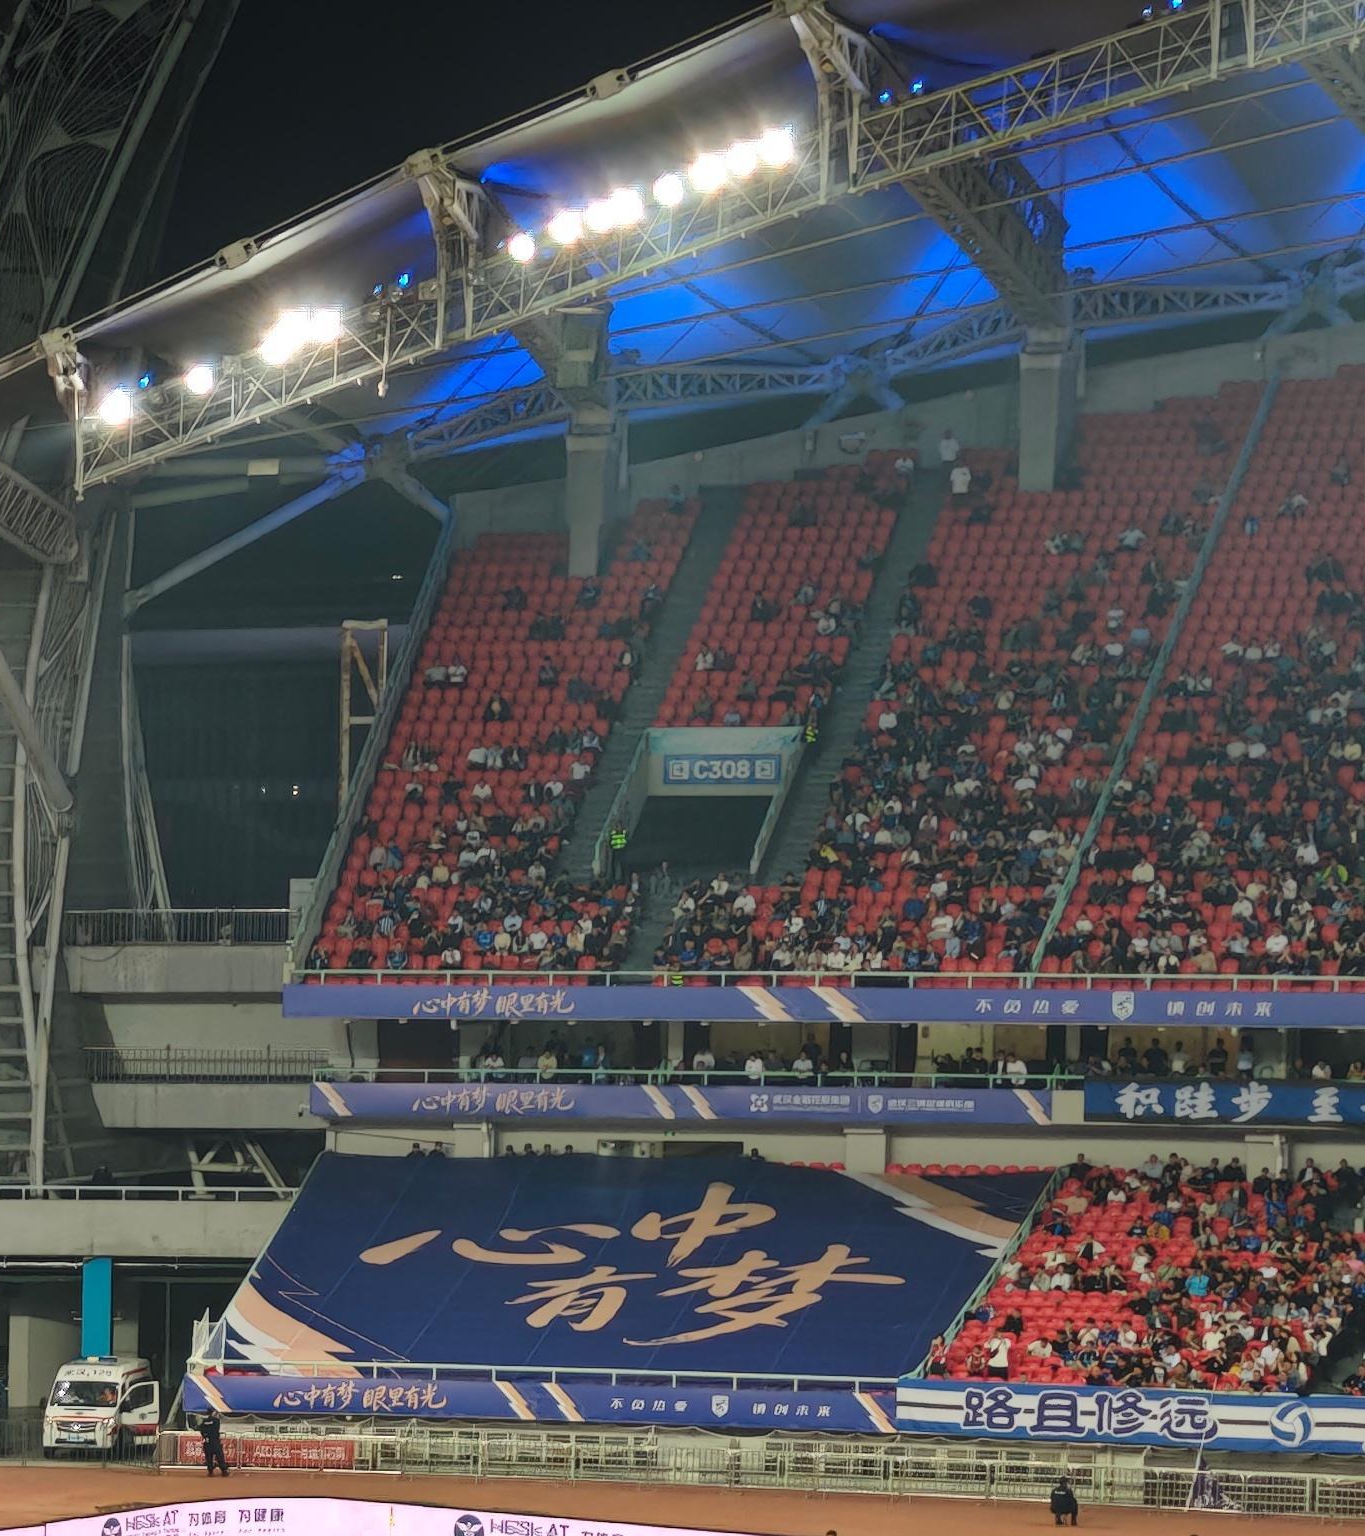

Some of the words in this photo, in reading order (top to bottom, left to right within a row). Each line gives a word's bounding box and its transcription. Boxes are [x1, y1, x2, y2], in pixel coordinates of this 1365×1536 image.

[692, 759, 751, 780] C308
[412, 986, 493, 1017] 心中有梦
[495, 988, 575, 1018] 眼里有光
[412, 1085, 492, 1115] 心中有梦
[495, 1086, 575, 1115] 眼里有光
[1115, 1081, 1273, 1123] 积跬步
[360, 1181, 778, 1267] 心中
[504, 1243, 906, 1347] 有梦
[273, 1379, 359, 1411] 心中有梦
[362, 1382, 447, 1412] 眼里有光
